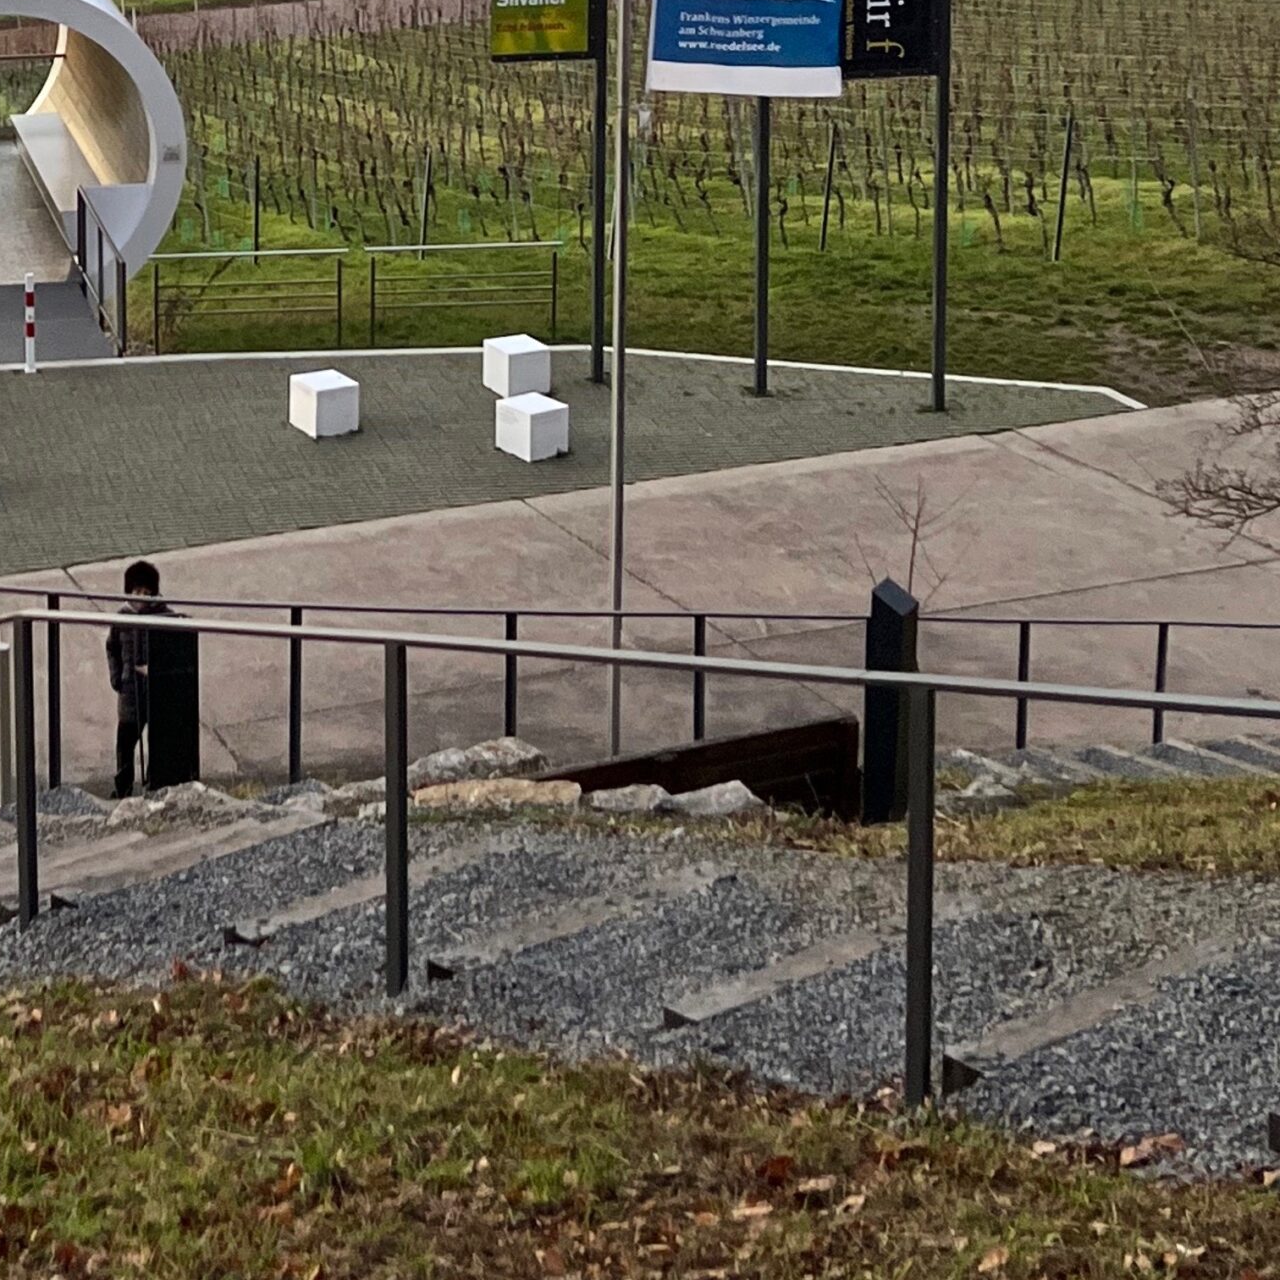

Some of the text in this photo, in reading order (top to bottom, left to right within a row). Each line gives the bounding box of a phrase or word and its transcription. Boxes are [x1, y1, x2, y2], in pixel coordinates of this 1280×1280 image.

[678, 25, 764, 40] am Schwanberg
[866, 38, 905, 58] f
